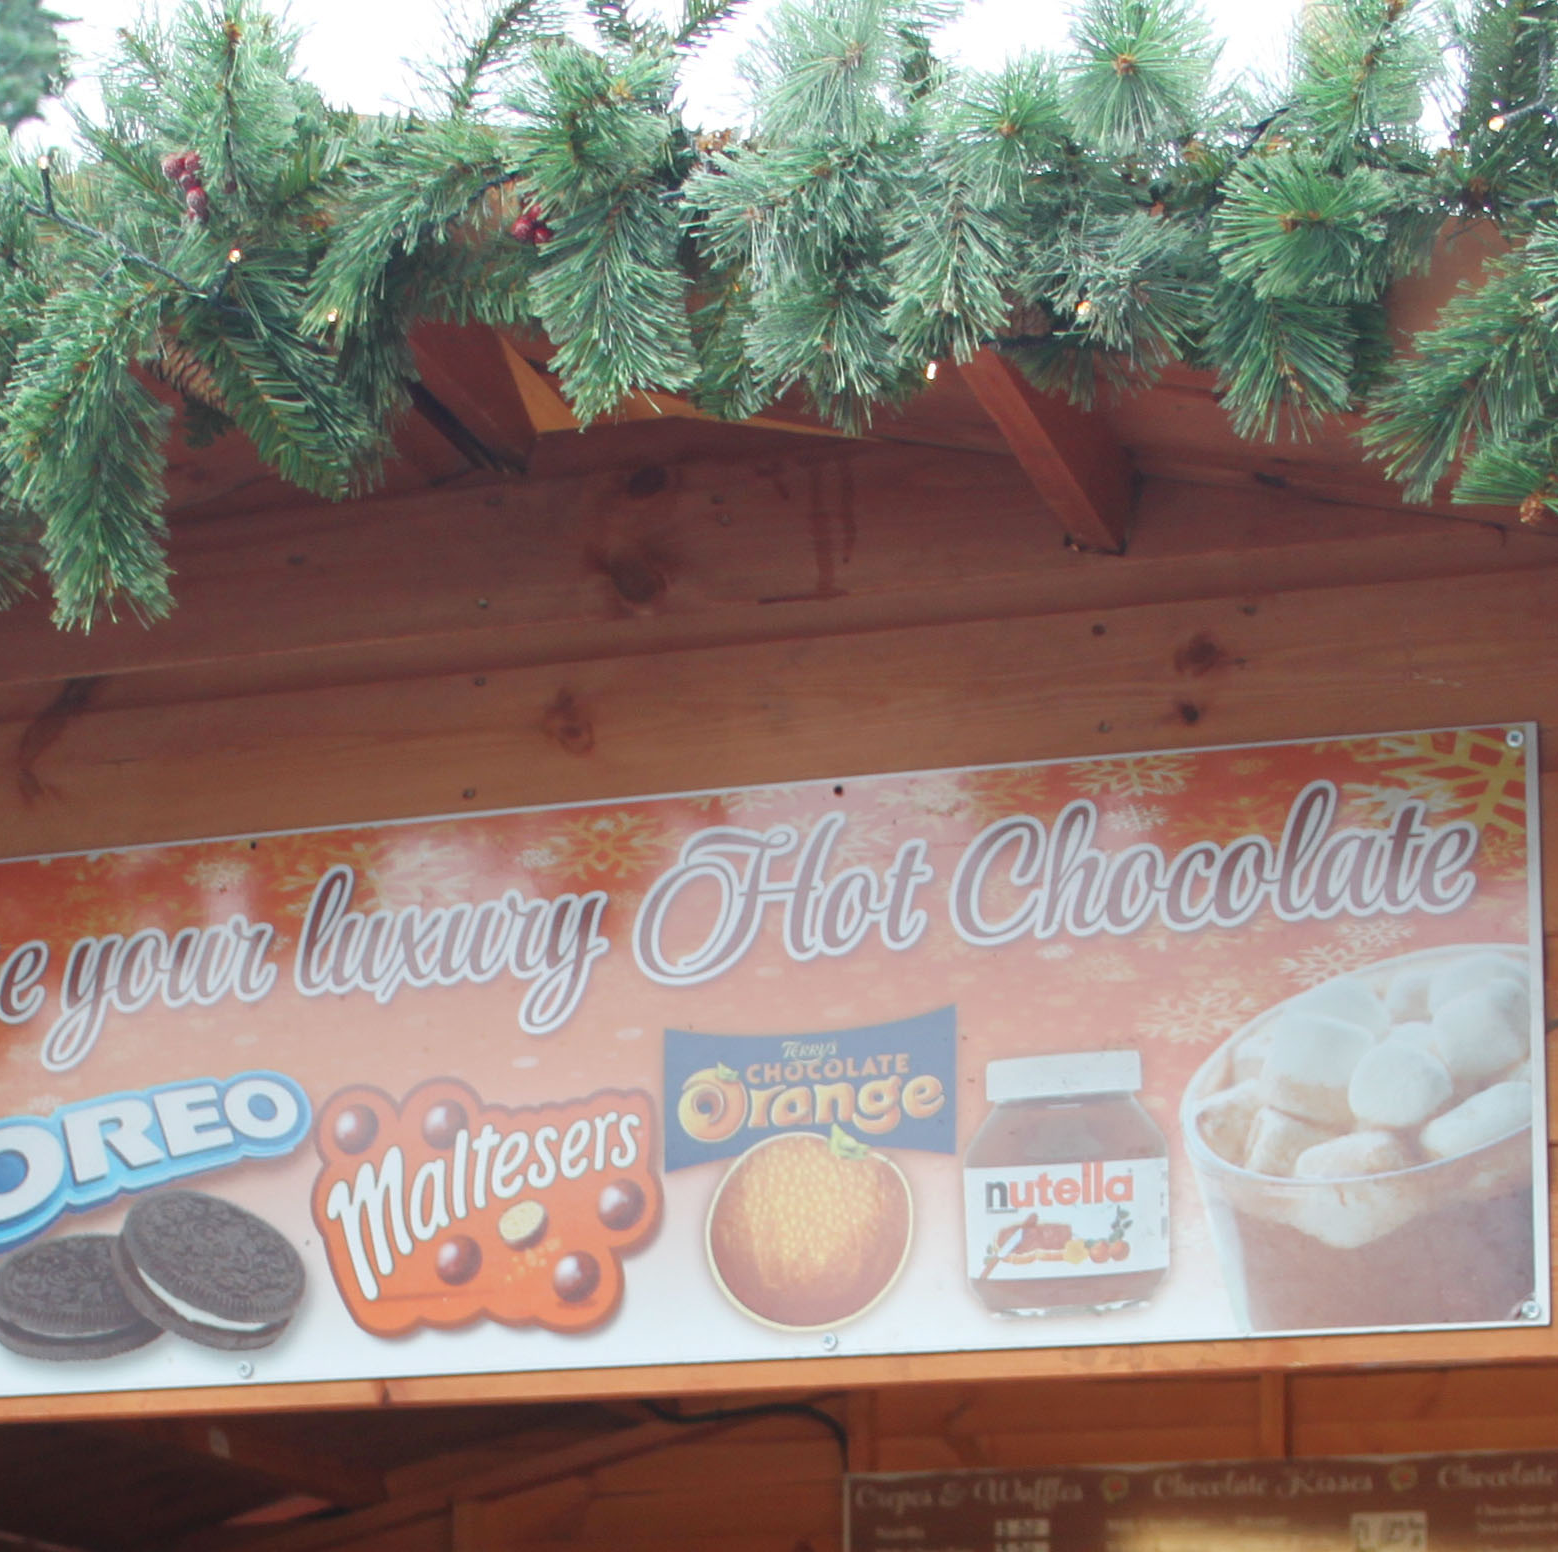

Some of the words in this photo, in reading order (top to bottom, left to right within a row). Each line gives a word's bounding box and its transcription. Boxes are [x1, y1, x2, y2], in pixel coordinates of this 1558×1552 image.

[42, 915, 276, 1072] your
[294, 863, 609, 1036] luxury
[632, 811, 933, 987] Hot
[946, 778, 1479, 948] Chocolate
[746, 1053, 910, 1084] CHOCOLATE
[677, 1064, 945, 1142] Orange
[327, 1110, 641, 1301] Maltesers
[985, 1160, 1134, 1209] nutella
[1152, 1470, 1268, 1499] Chocolate
[1437, 1459, 1557, 1489] Chocolate
